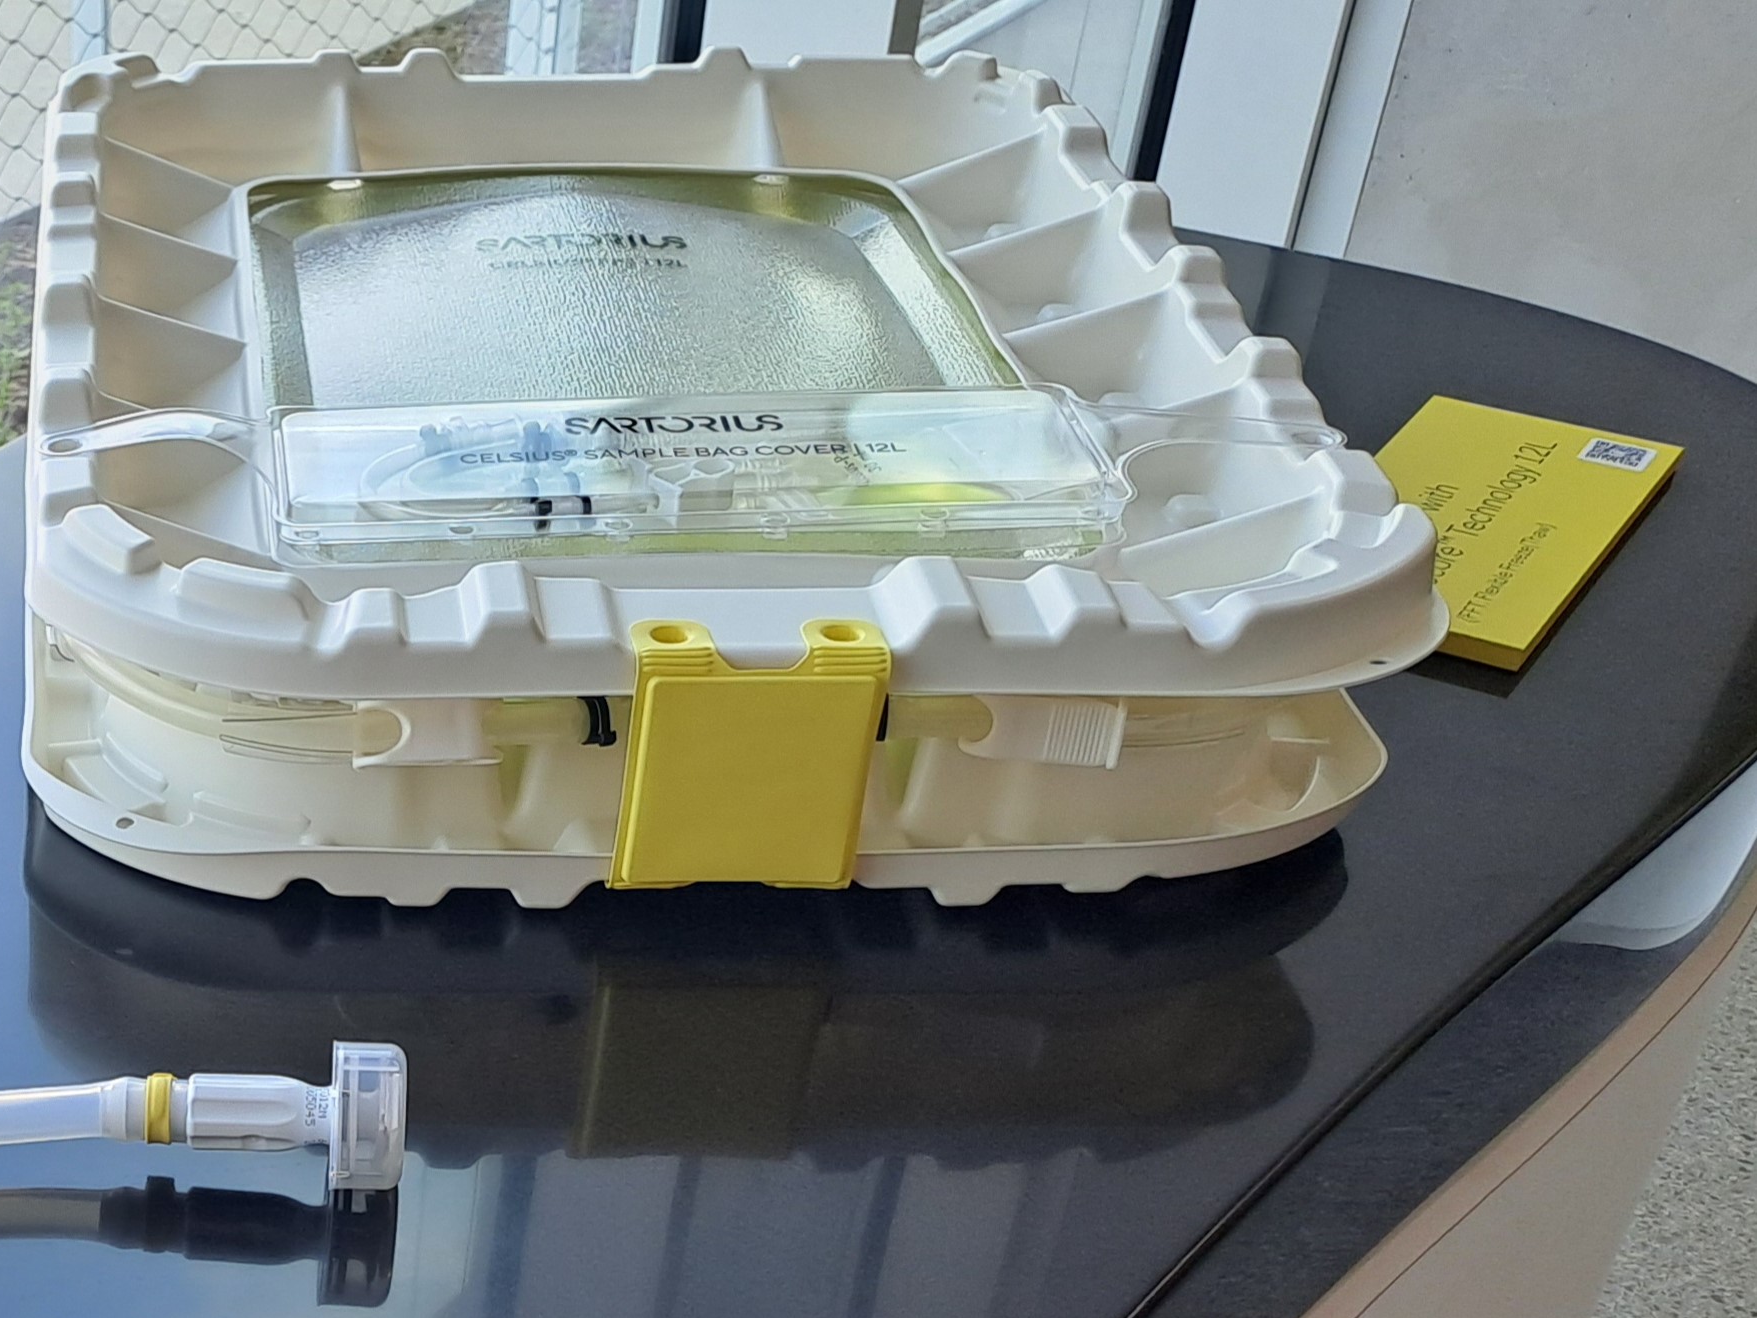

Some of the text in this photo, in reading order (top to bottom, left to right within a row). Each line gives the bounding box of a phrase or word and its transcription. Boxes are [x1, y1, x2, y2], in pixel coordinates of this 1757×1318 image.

[564, 414, 784, 435] SARTORIUS
[460, 449, 578, 465] CELSIUS®
[584, 447, 688, 461] SAMPLE
[694, 445, 748, 458] BAG
[754, 443, 847, 456] COVER
[865, 442, 908, 454] 12L
[1418, 484, 1460, 511] with
[1445, 464, 1542, 536] Technology
[1514, 442, 1558, 464] 12L
